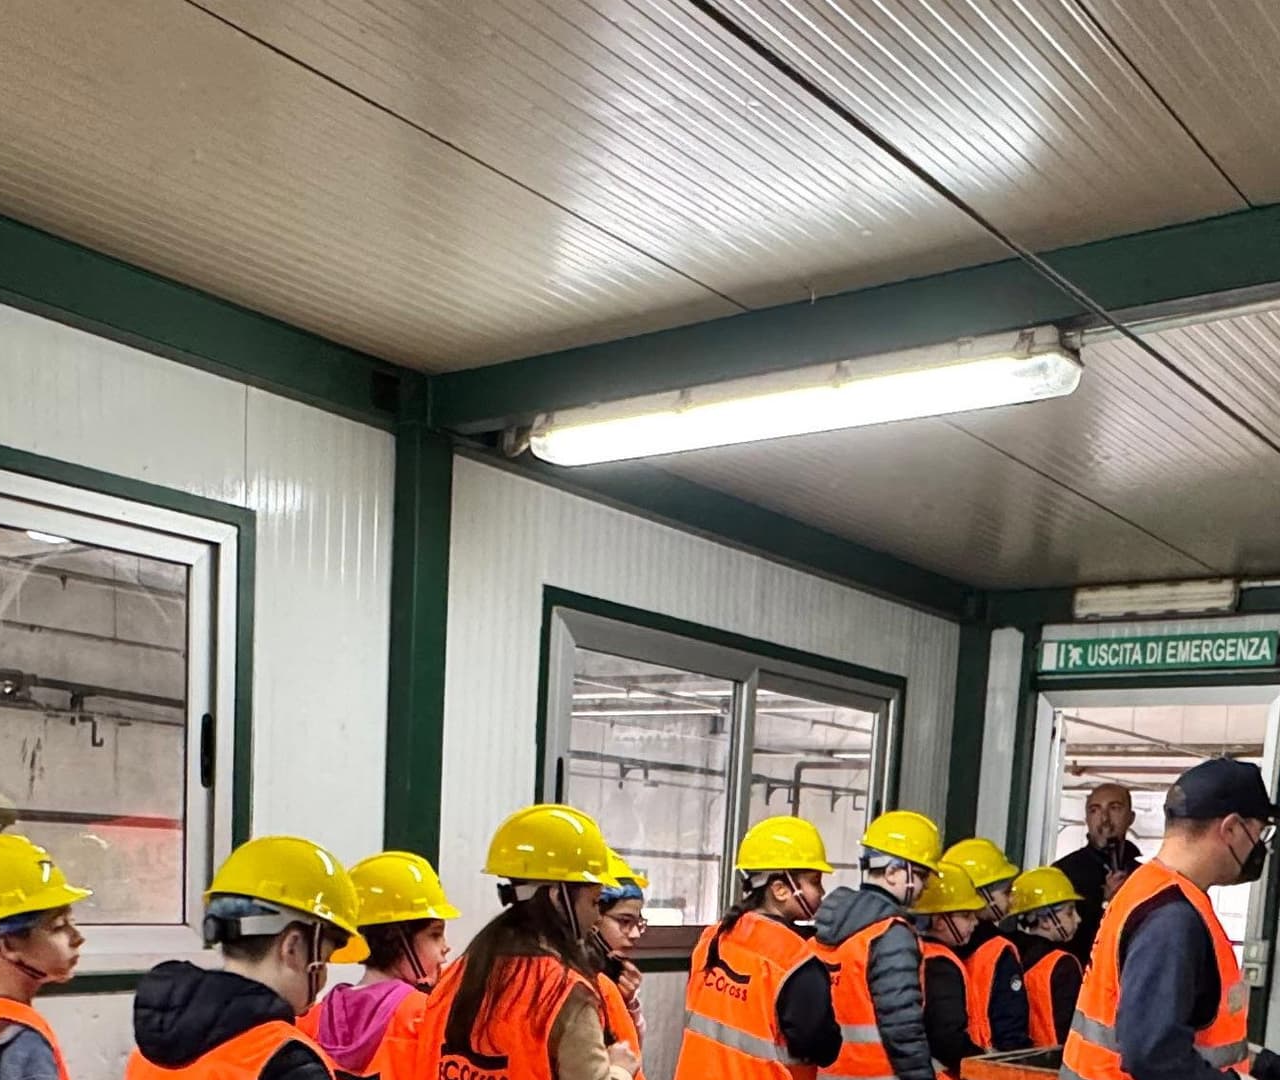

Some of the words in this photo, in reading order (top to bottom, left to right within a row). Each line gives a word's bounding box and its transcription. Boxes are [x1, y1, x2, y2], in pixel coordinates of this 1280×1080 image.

[1088, 641, 1142, 665] USCITA
[1146, 642, 1162, 663] DI
[1165, 638, 1272, 663] EMERGENZA
